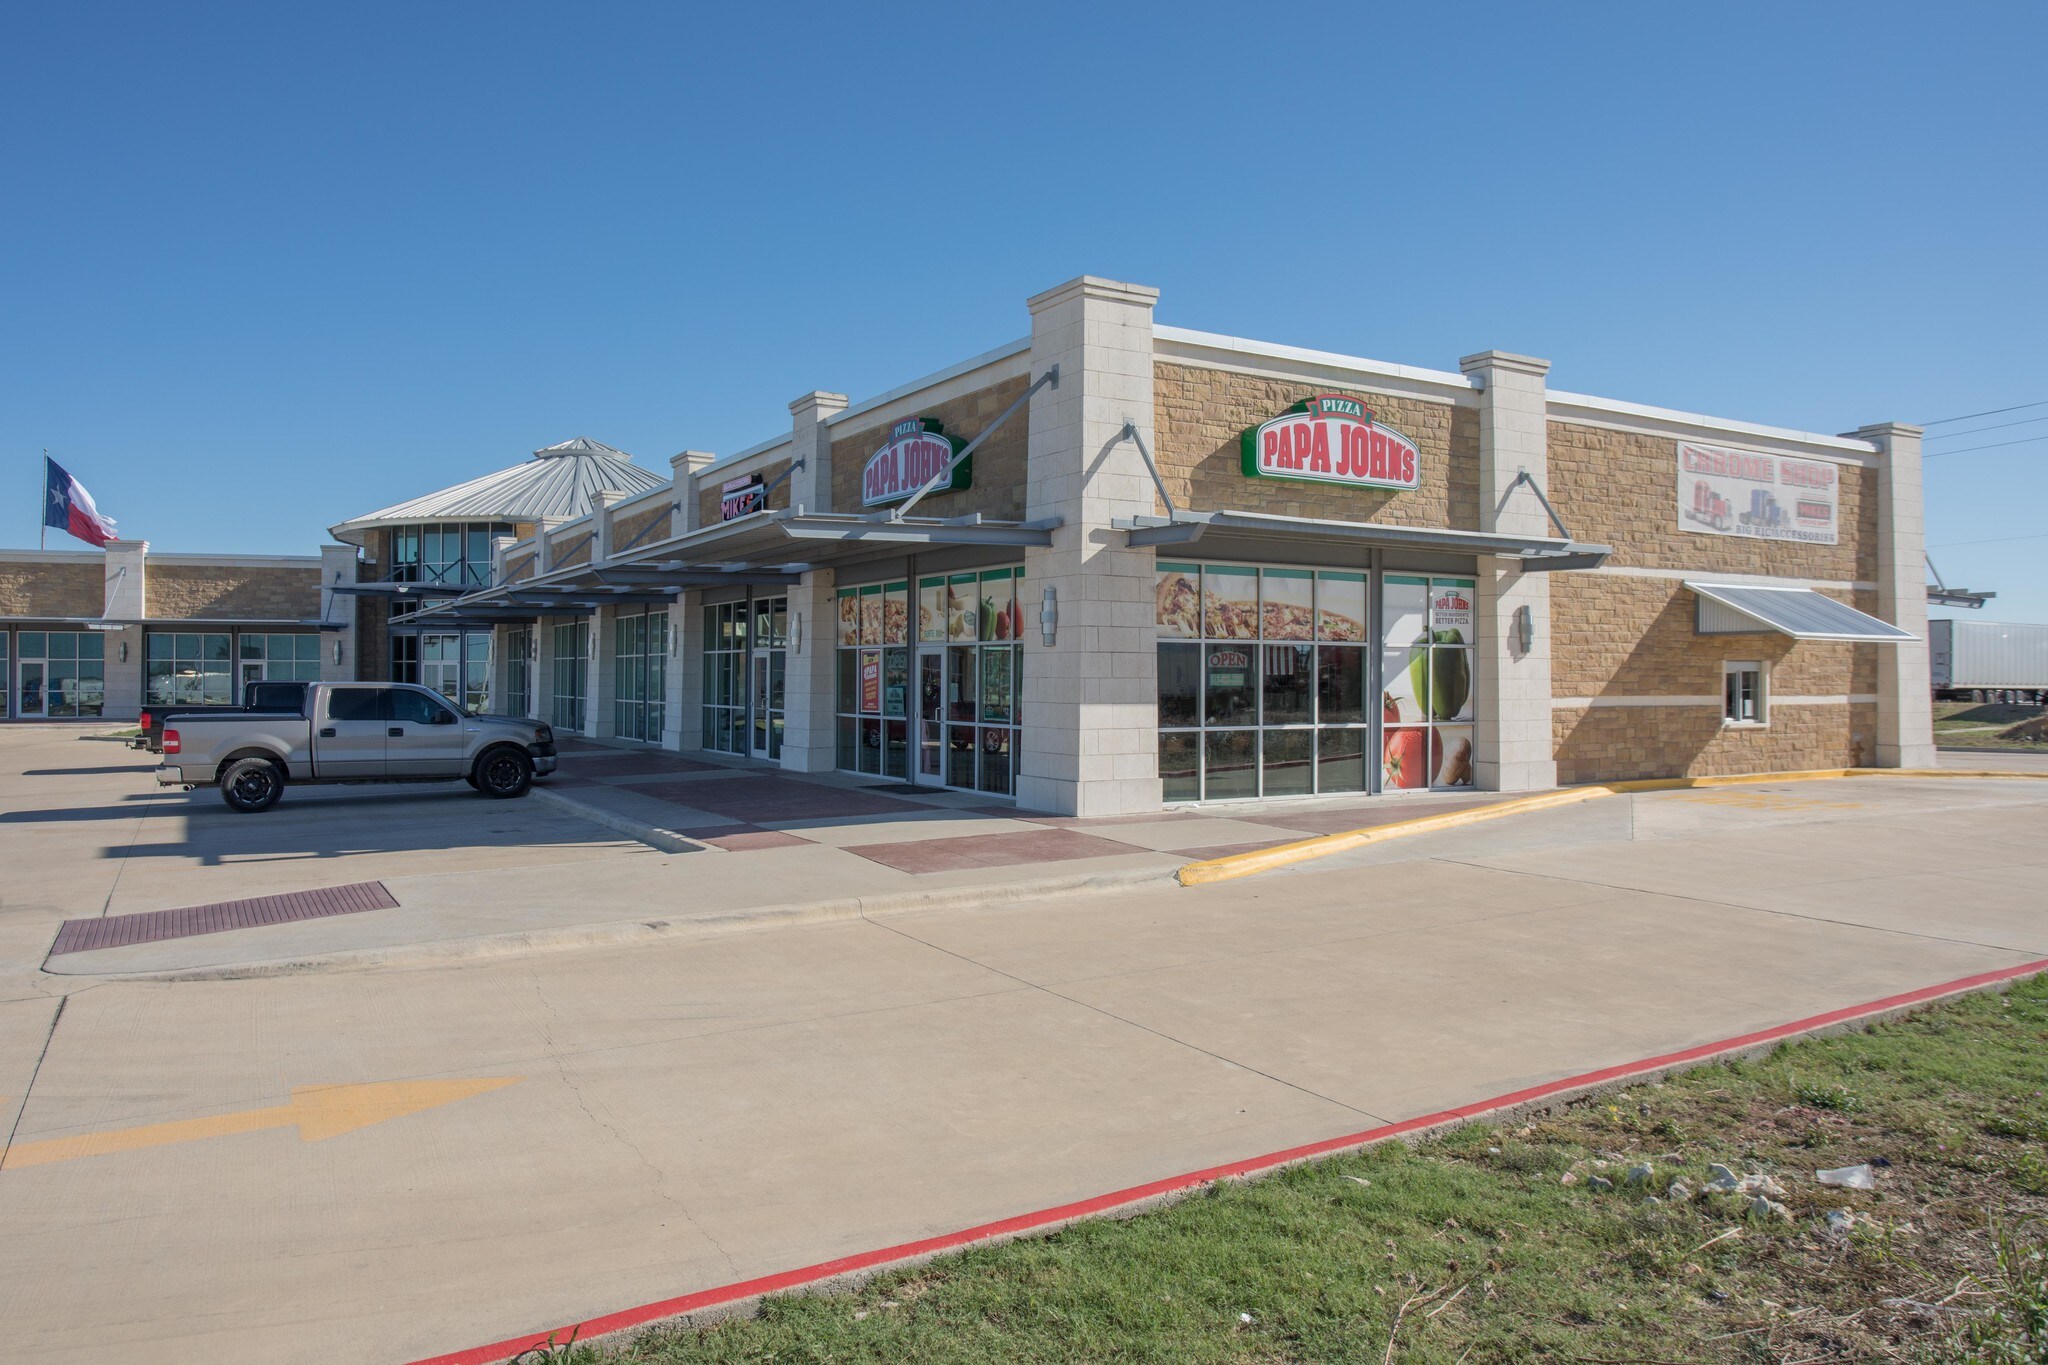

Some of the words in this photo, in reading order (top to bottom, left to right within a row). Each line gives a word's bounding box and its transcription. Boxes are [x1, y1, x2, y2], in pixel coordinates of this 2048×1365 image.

[1321, 399, 1362, 417] PIZZA
[894, 420, 916, 437] PIZZA
[1263, 422, 1331, 473] PAPA
[865, 446, 899, 500] PAPA
[1683, 446, 1775, 483] CHROME
[1780, 459, 1834, 490] SHOP
[1735, 524, 1752, 535] BIG
[1754, 526, 1771, 537] RIG
[1772, 528, 1835, 543] ACCESSORIES
[1435, 597, 1450, 609] PAPA
[1209, 652, 1246, 666] OPEN
